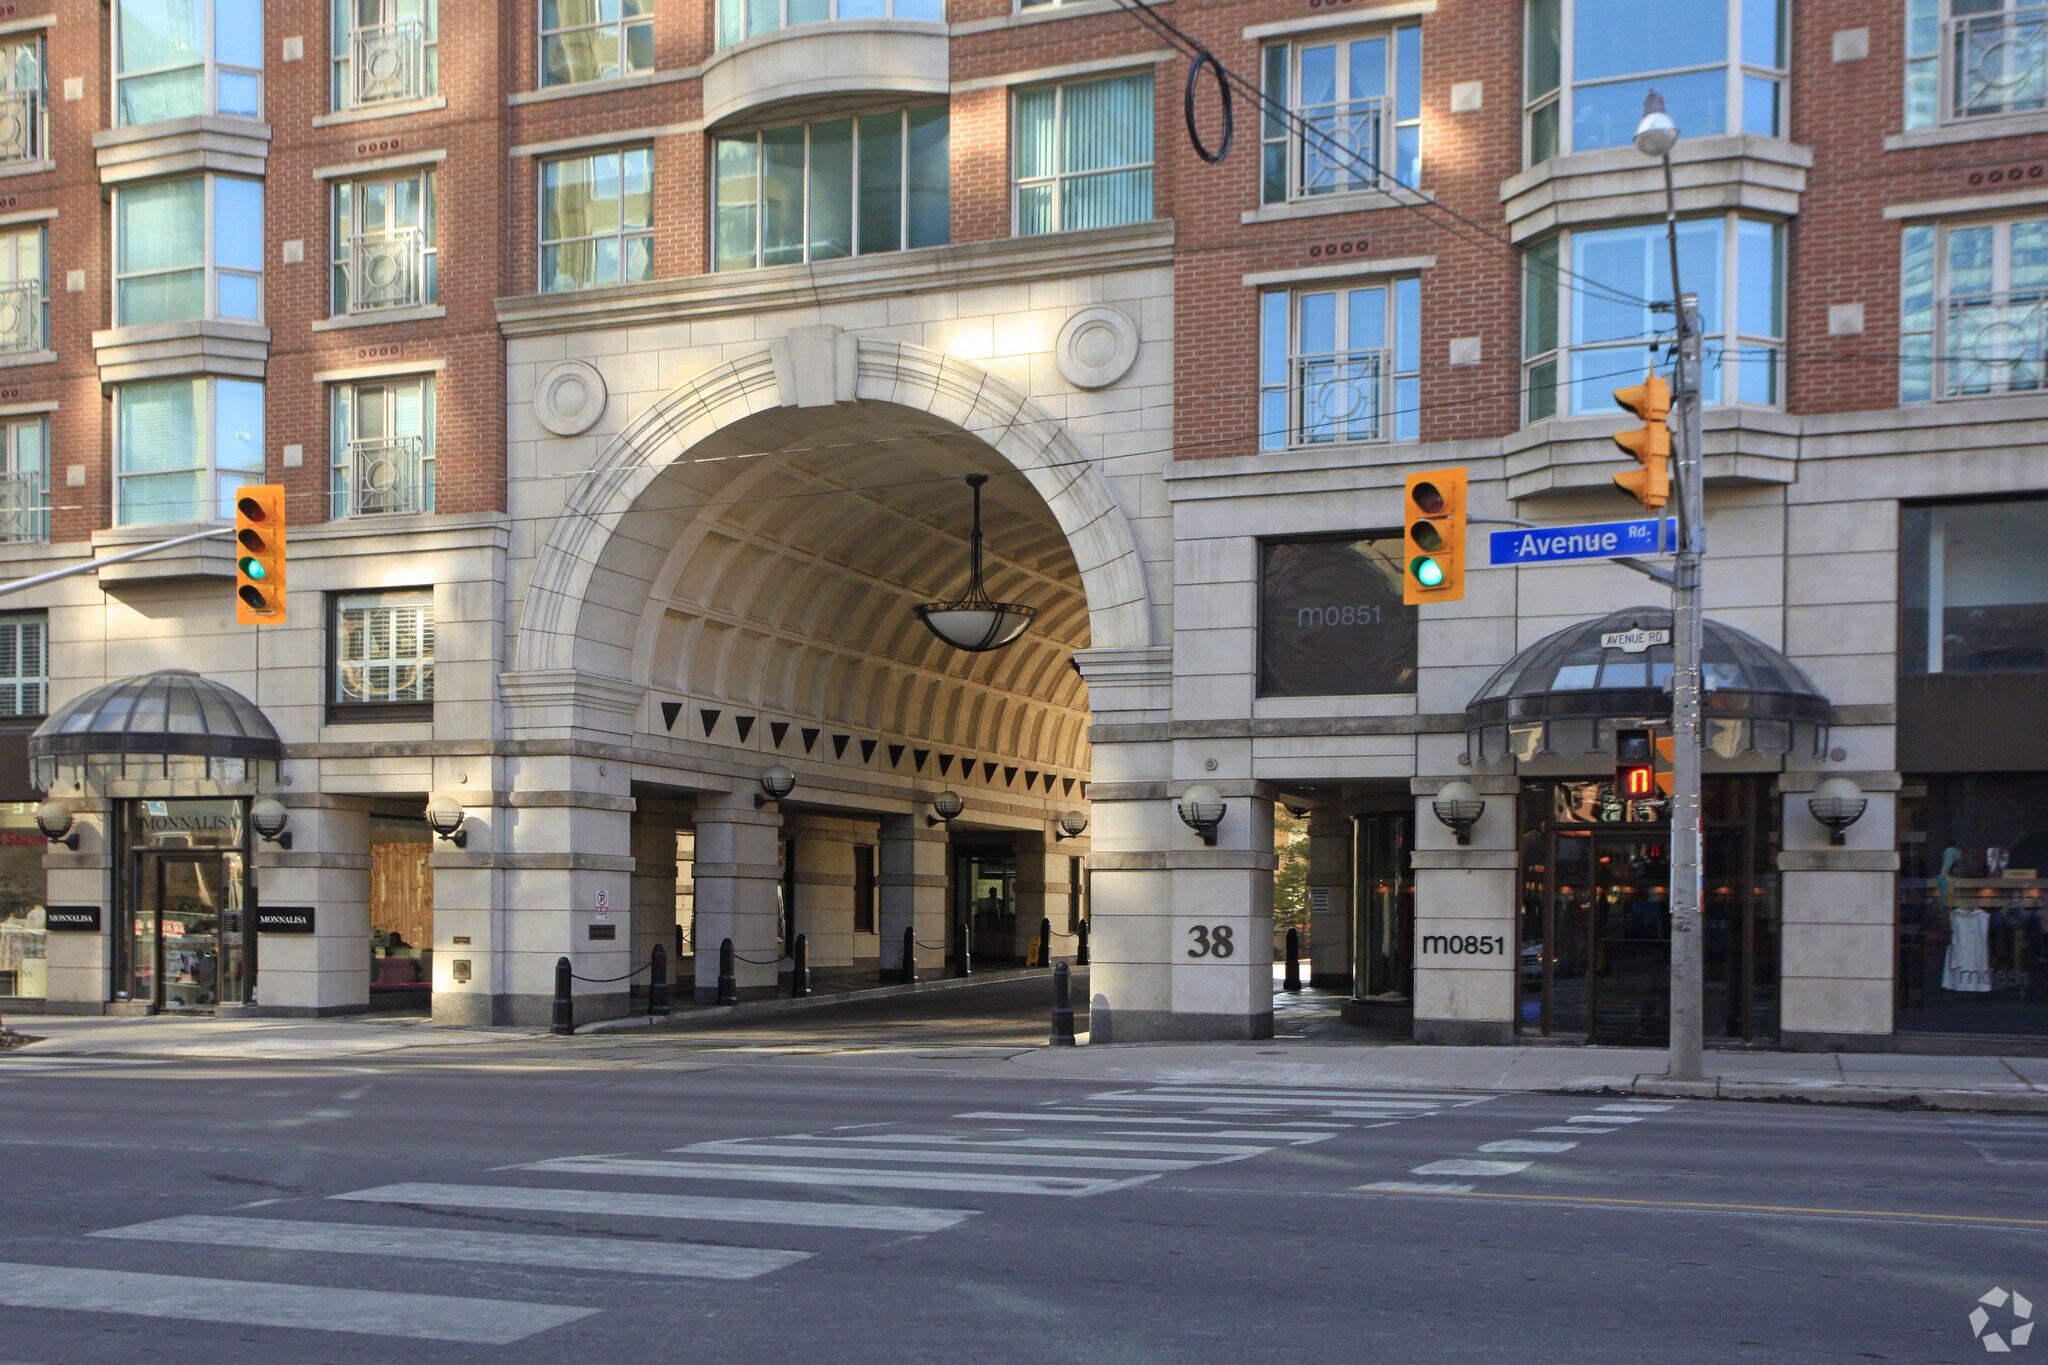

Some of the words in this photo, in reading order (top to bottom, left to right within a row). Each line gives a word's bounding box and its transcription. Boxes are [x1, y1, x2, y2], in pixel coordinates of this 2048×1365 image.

[1518, 531, 1618, 557] Avenue
[1297, 604, 1382, 626] m0851
[1606, 632, 1645, 645] AVENUE
[141, 815, 239, 830] MONNALISA
[48, 914, 93, 922] MONNALISA
[260, 915, 307, 924] MONNALISA
[1187, 924, 1234, 958] 38
[1422, 935, 1504, 955] m0851
